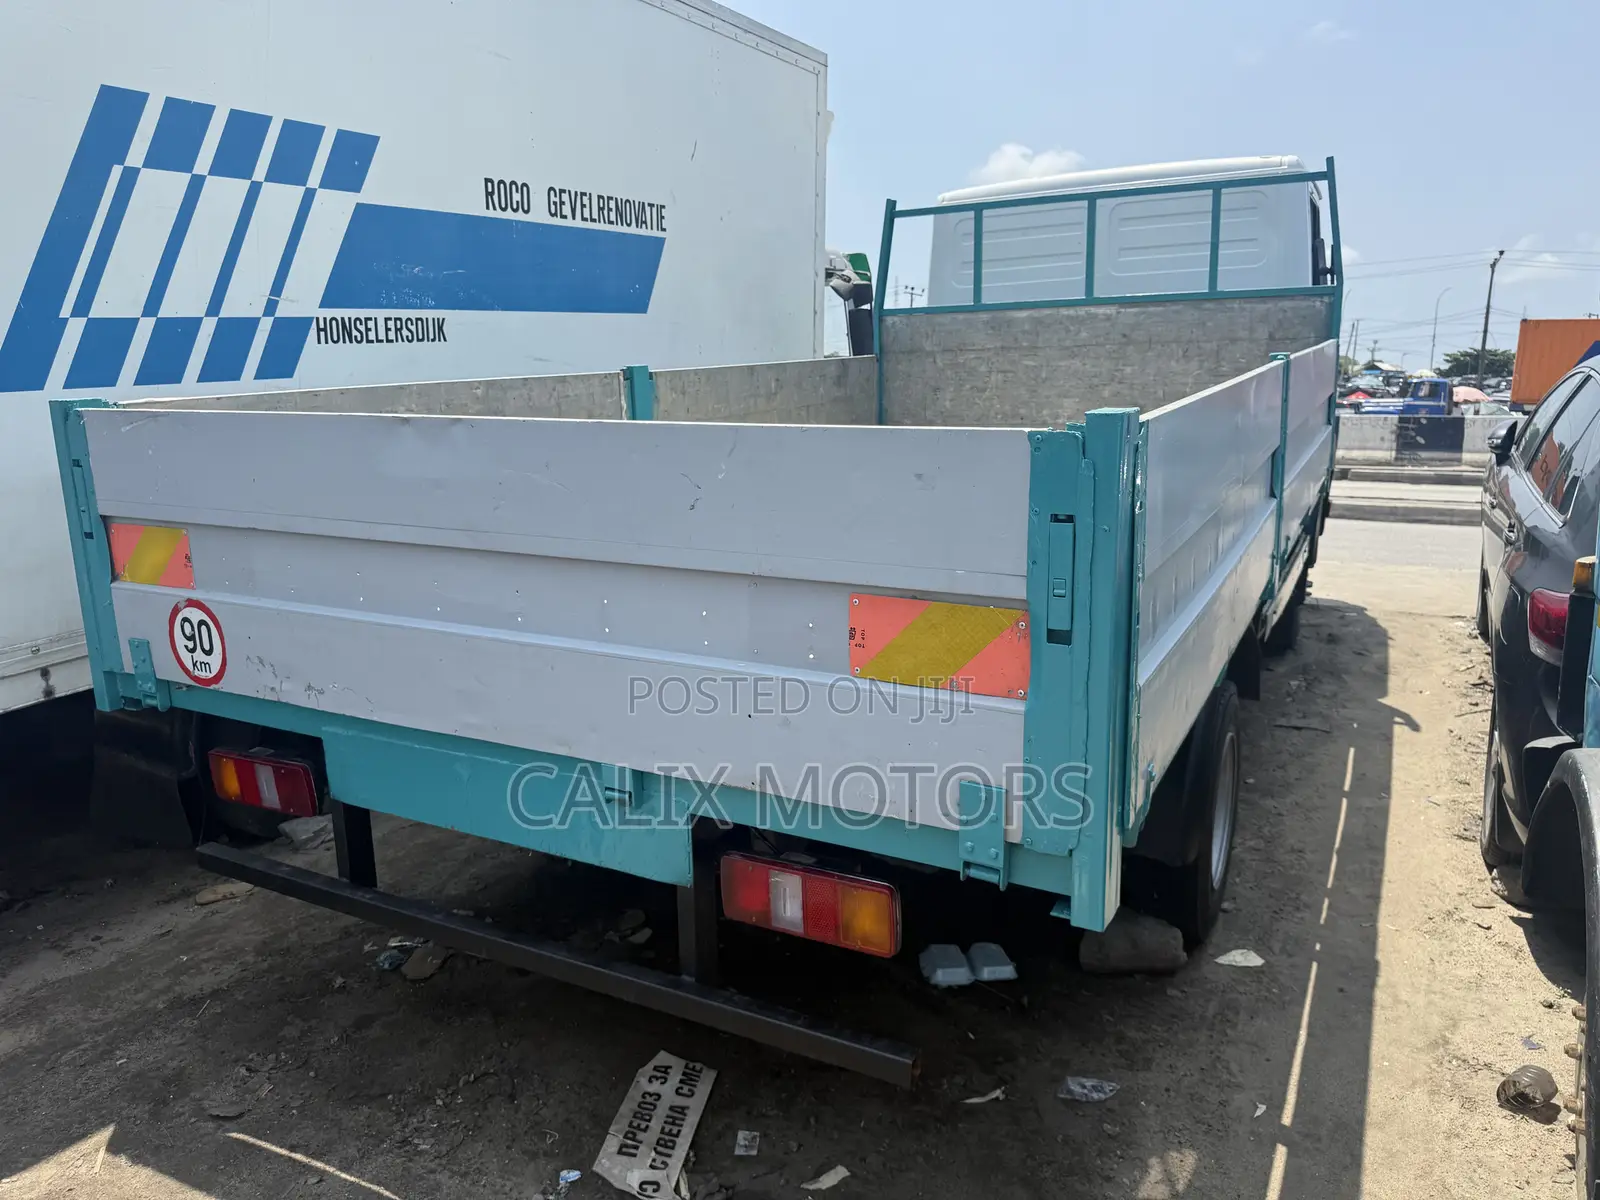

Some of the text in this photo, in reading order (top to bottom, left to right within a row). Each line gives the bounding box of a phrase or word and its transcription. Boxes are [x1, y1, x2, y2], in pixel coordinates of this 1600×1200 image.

[484, 177, 667, 232] ROCO GEVELRENOVATIE
[315, 316, 448, 345] HONSELERSDIJK
[180, 616, 214, 656] 90
[191, 655, 212, 674] km
[616, 1091, 662, 1158] ПРЕВОЗ
[647, 1064, 673, 1085] ЗА
